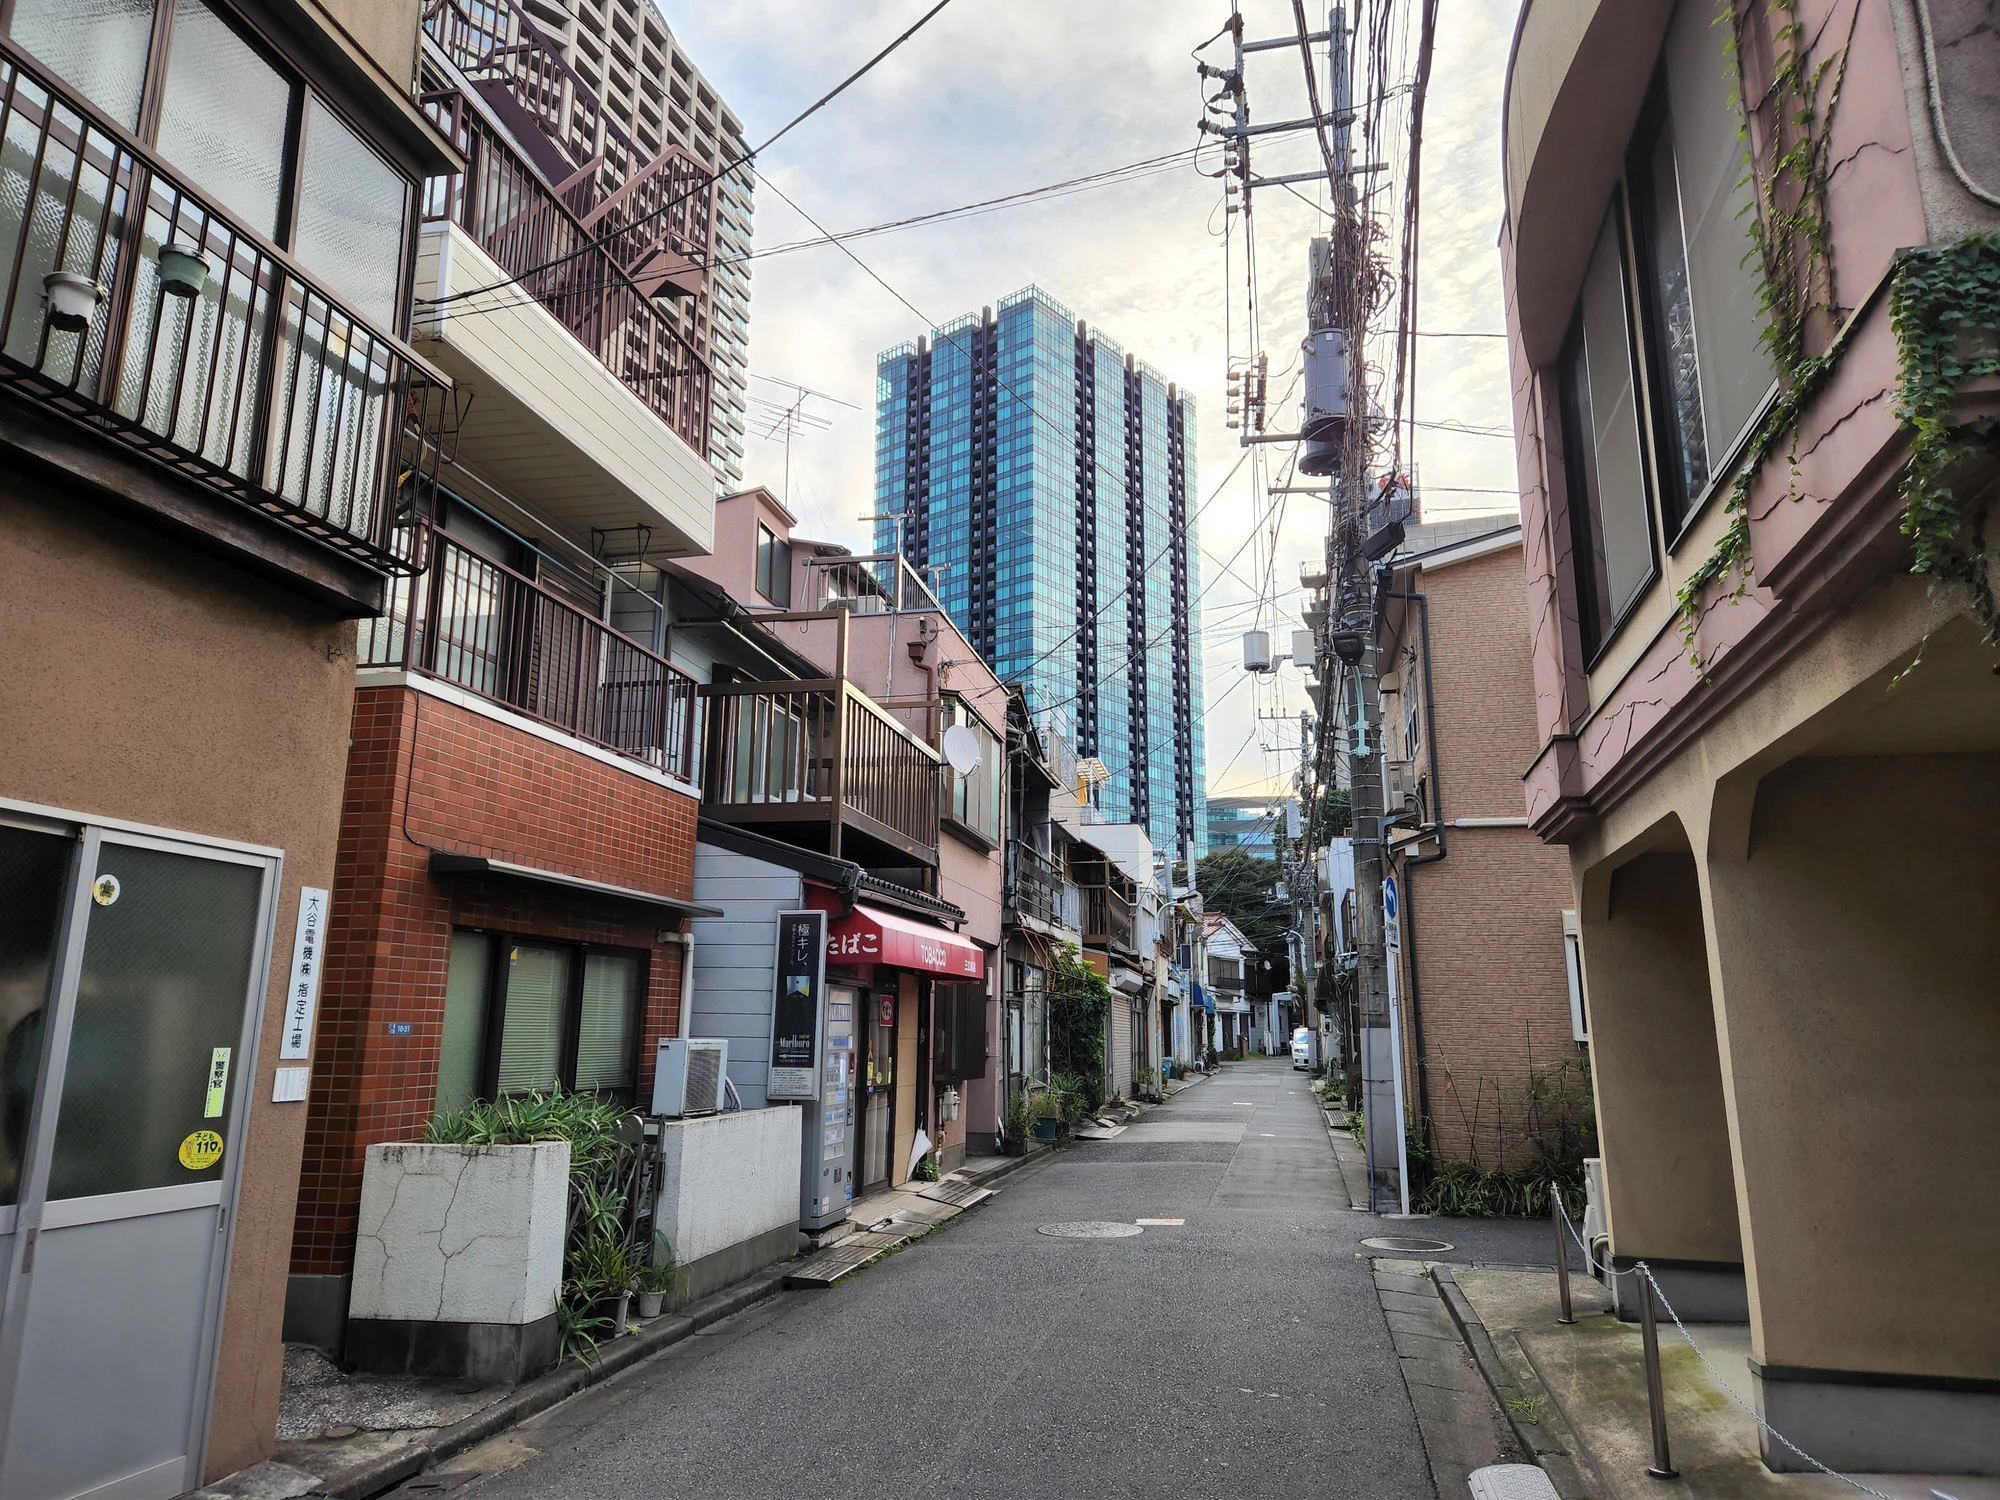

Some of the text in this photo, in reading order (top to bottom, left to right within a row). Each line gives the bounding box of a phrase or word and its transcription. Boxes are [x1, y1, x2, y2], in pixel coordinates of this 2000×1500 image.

[825, 932, 879, 956] たばこ
[920, 944, 947, 967] TOBACCO
[397, 1025, 410, 1033] 10-21
[779, 1034, 811, 1048] Marlboro
[195, 1132, 215, 1142] 子ども
